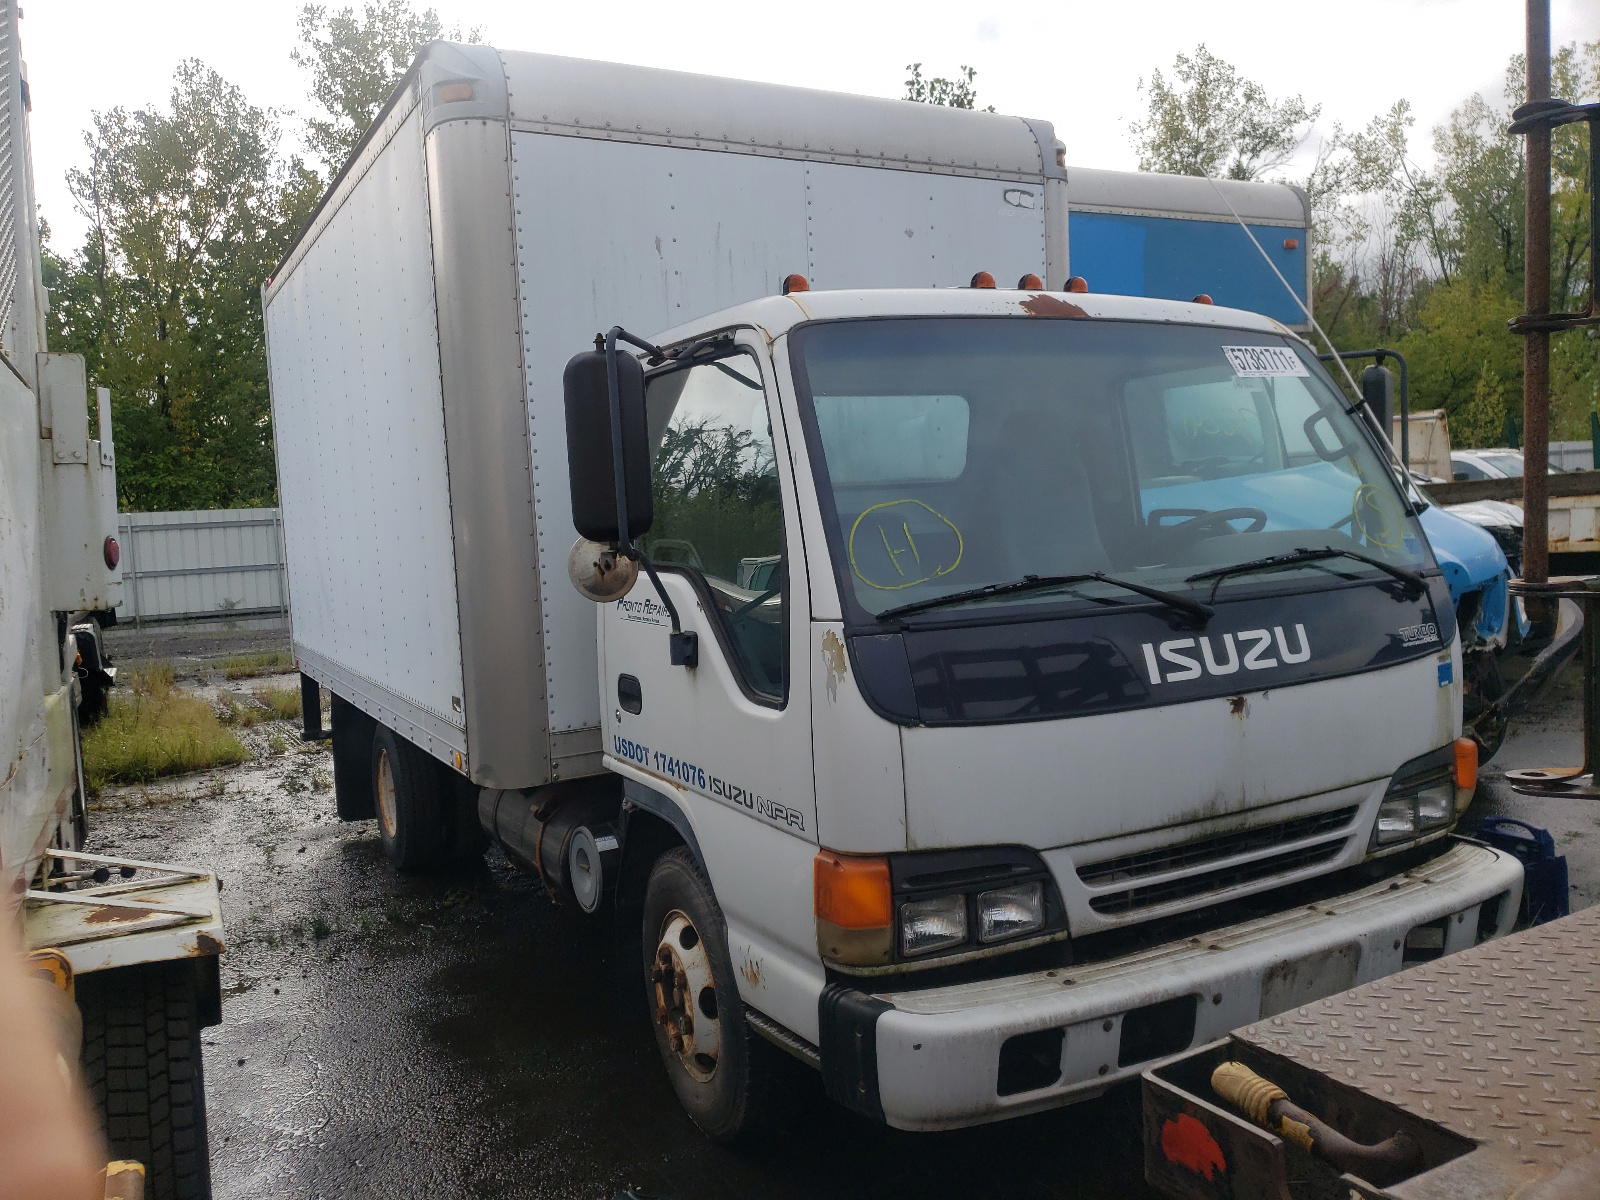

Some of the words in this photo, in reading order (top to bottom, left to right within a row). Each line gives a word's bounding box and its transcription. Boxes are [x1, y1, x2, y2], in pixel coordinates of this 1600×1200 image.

[1141, 623, 1312, 686] ISUZU
[1398, 622, 1438, 642] TURBO
[613, 734, 650, 767] USDOT
[653, 751, 706, 790] 1741076
[708, 775, 754, 810] ISUZU
[756, 795, 805, 832] NPR
